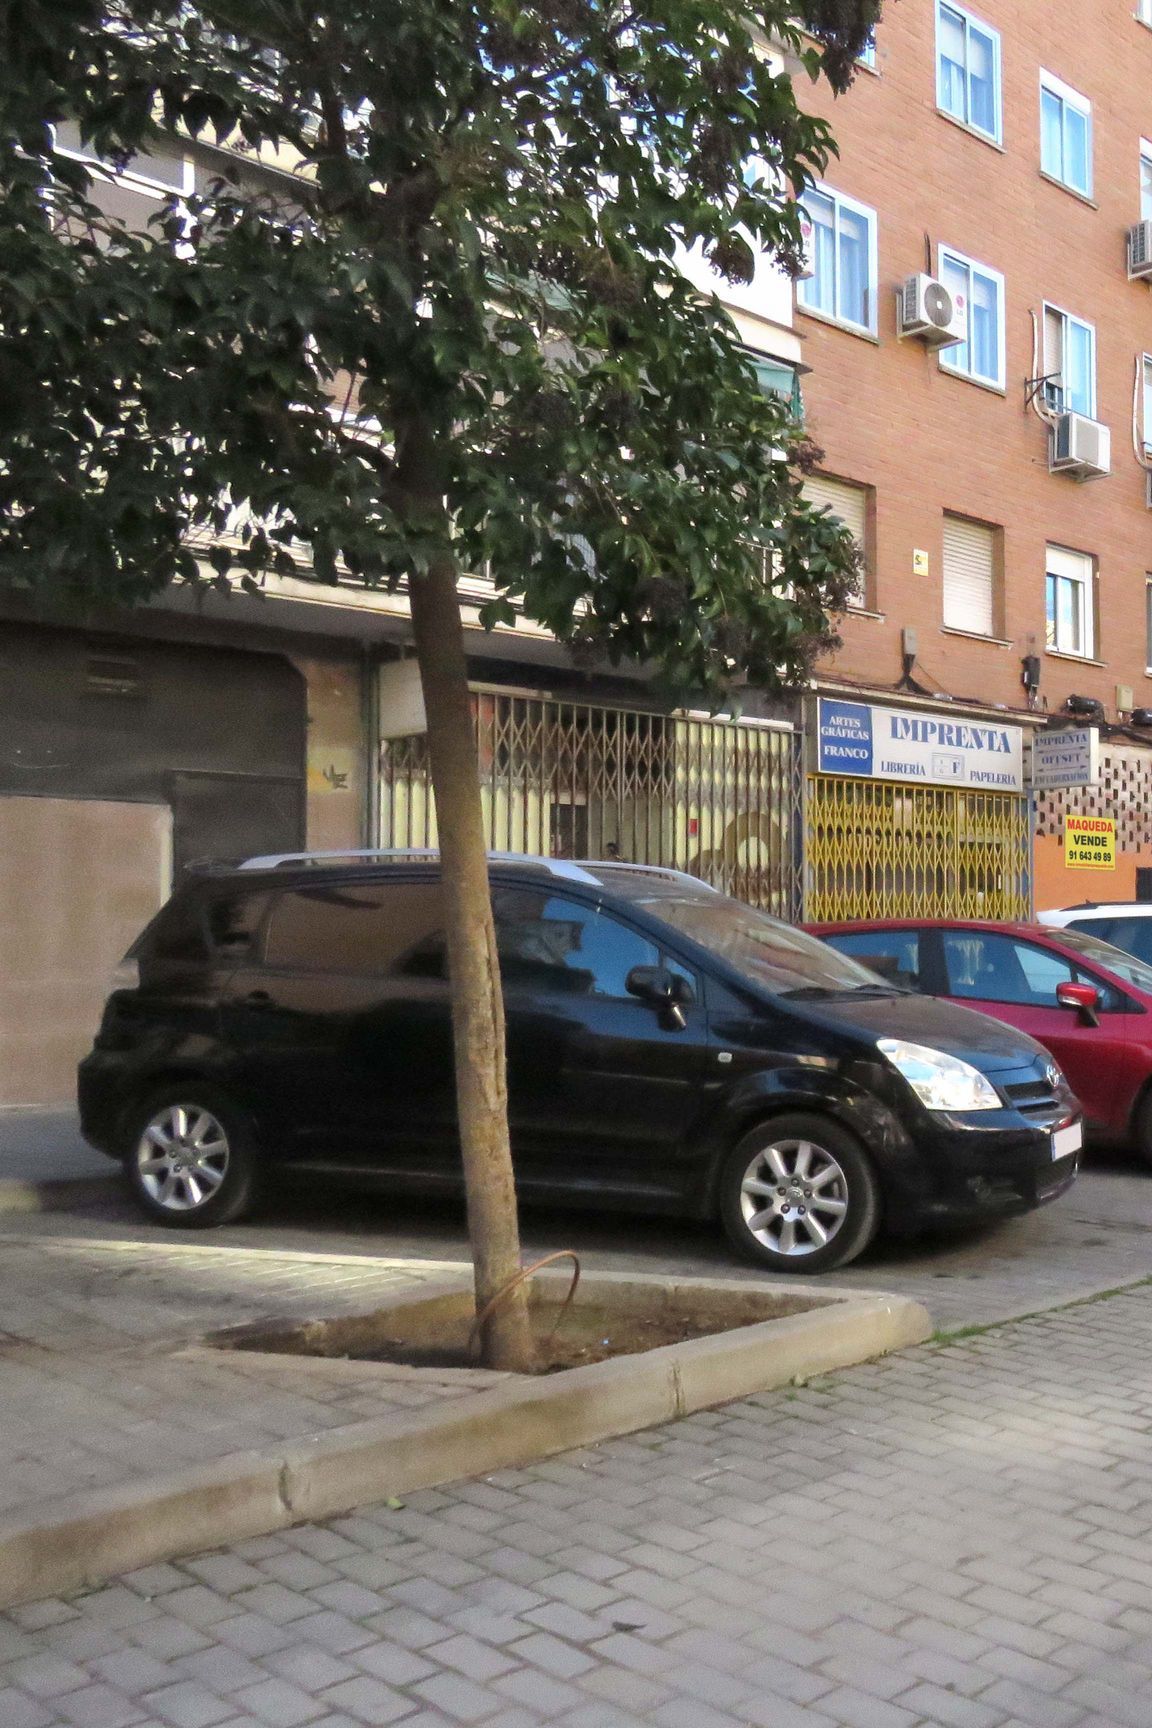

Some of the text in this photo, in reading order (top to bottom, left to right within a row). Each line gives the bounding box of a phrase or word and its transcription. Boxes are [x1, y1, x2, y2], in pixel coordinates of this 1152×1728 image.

[829, 715, 861, 728] ARTES
[821, 724, 870, 741] GRÁFICAS
[891, 715, 1012, 754] IMPRENTA
[823, 744, 869, 760] FRANCO
[881, 760, 927, 777] LIBRERÍA
[1067, 818, 1114, 833] MAQUEDA
[1073, 834, 1108, 847] VENDE
[1069, 850, 1111, 862] 91 643 49 89
